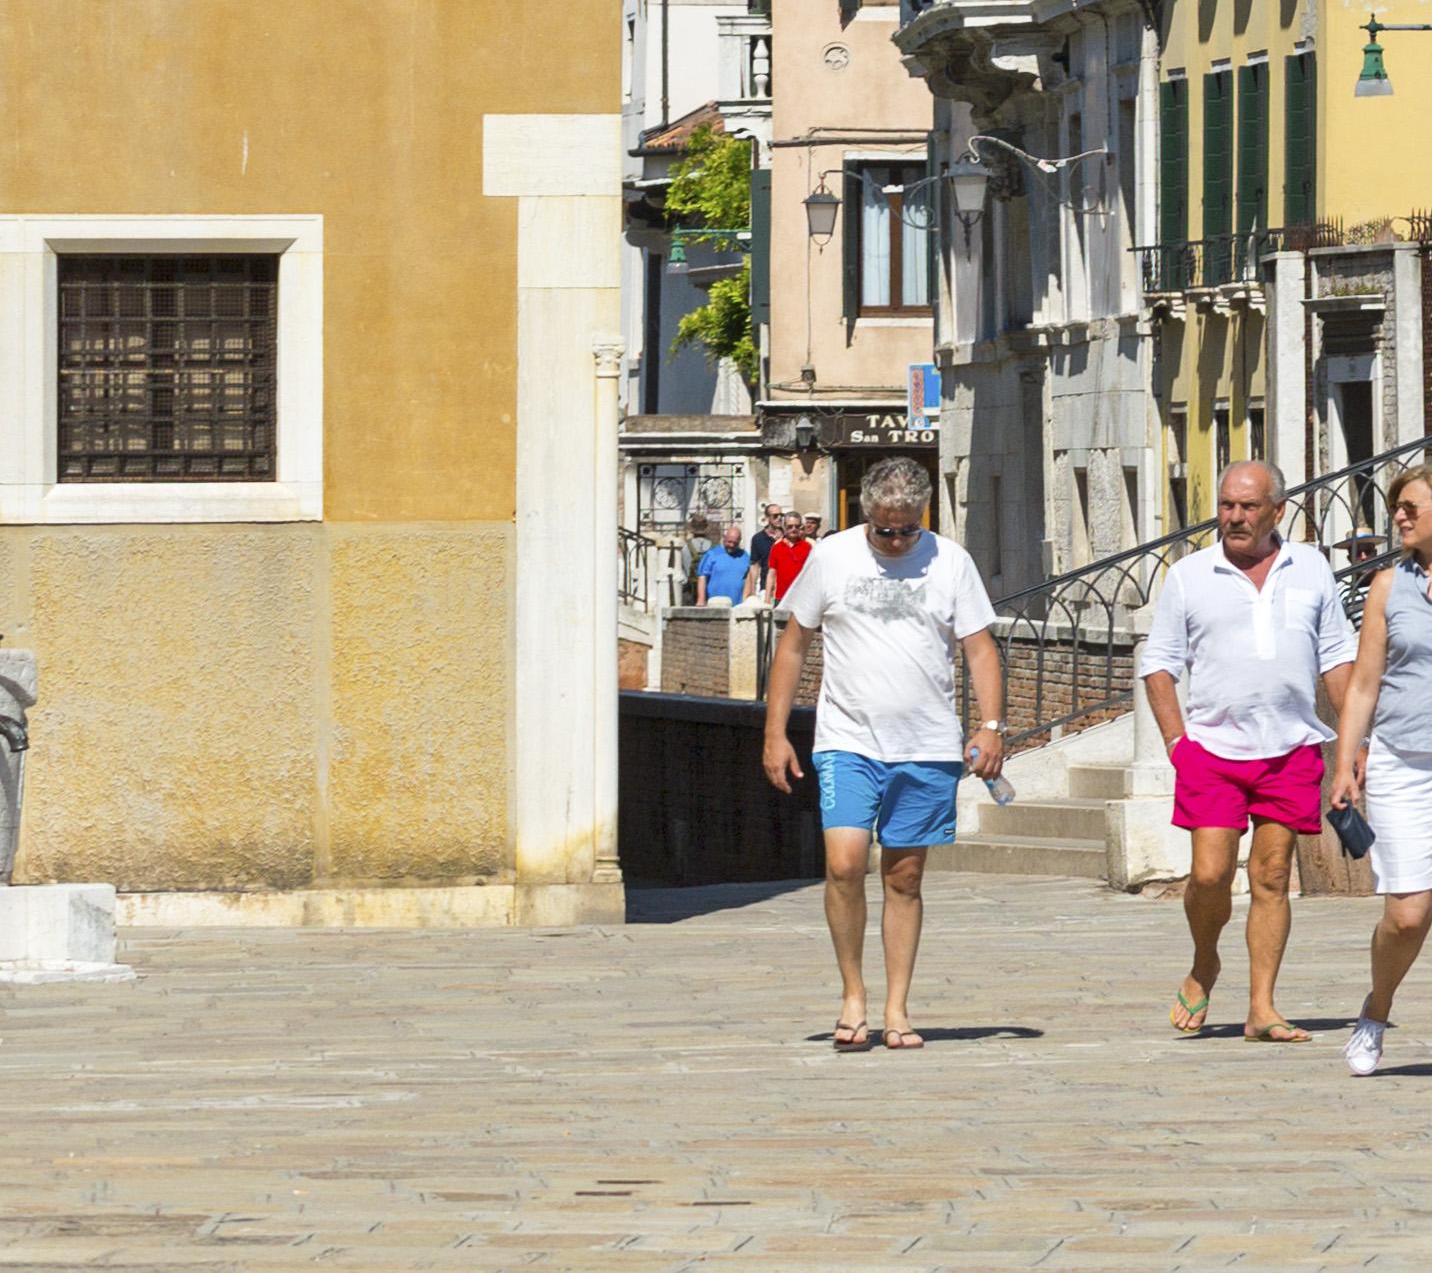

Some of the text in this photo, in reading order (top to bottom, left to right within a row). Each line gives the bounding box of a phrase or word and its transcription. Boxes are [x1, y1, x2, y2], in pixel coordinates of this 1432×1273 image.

[865, 414, 909, 428] TAV
[850, 430, 935, 443] San TRO
